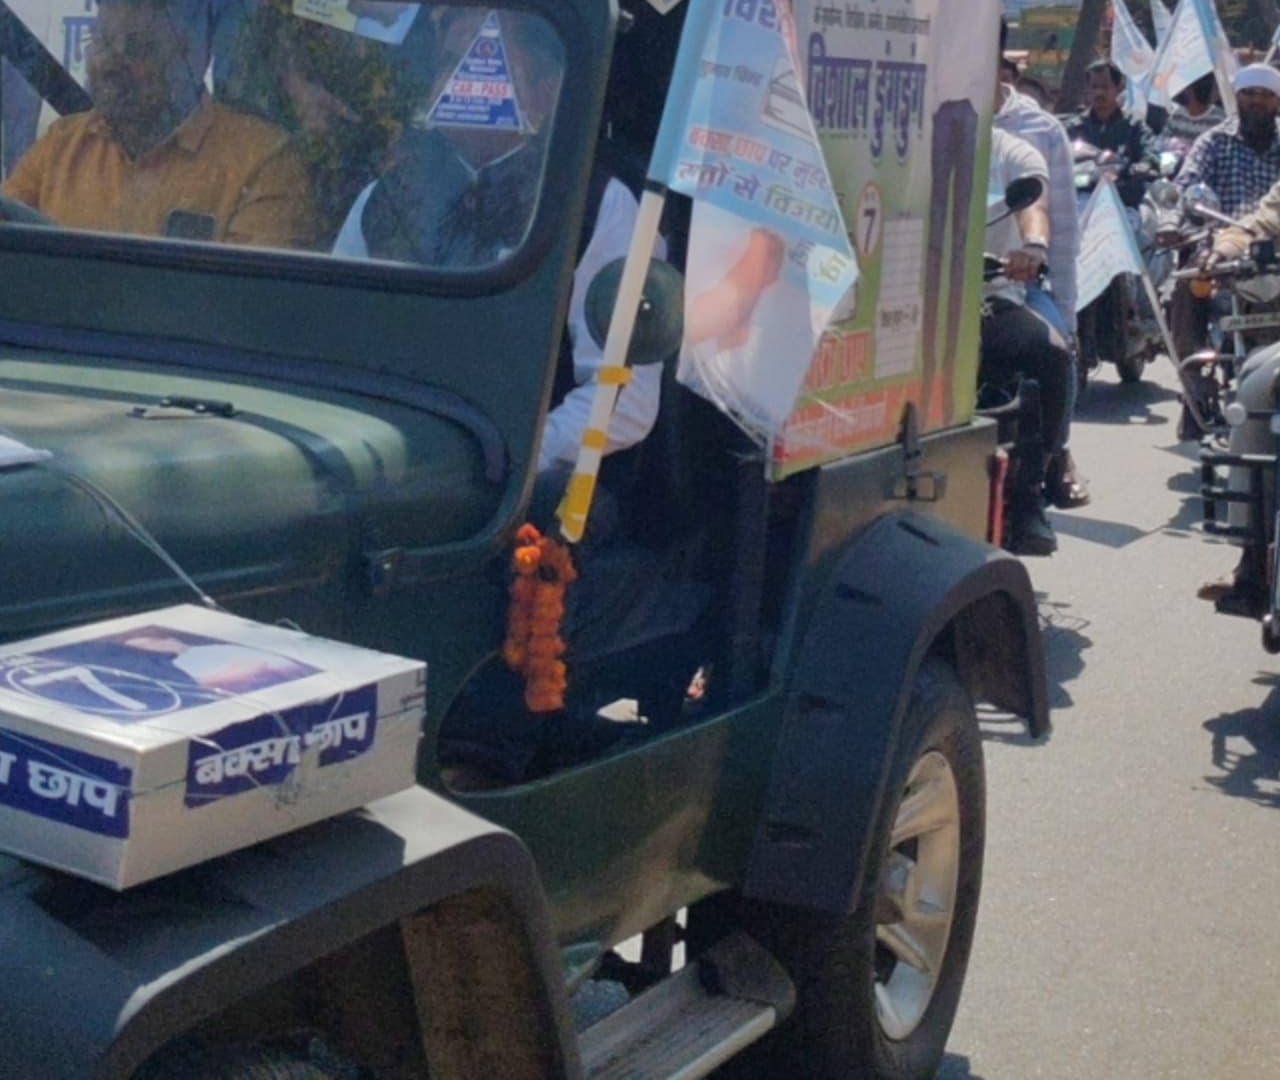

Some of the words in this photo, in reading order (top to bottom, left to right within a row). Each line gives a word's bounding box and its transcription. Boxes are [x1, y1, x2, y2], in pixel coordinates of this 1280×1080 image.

[480, 82, 508, 96] PASS
[862, 208, 876, 255] 7
[21, 666, 148, 711] 7
[195, 735, 300, 786] बक्सा
[27, 760, 123, 817] छाप
